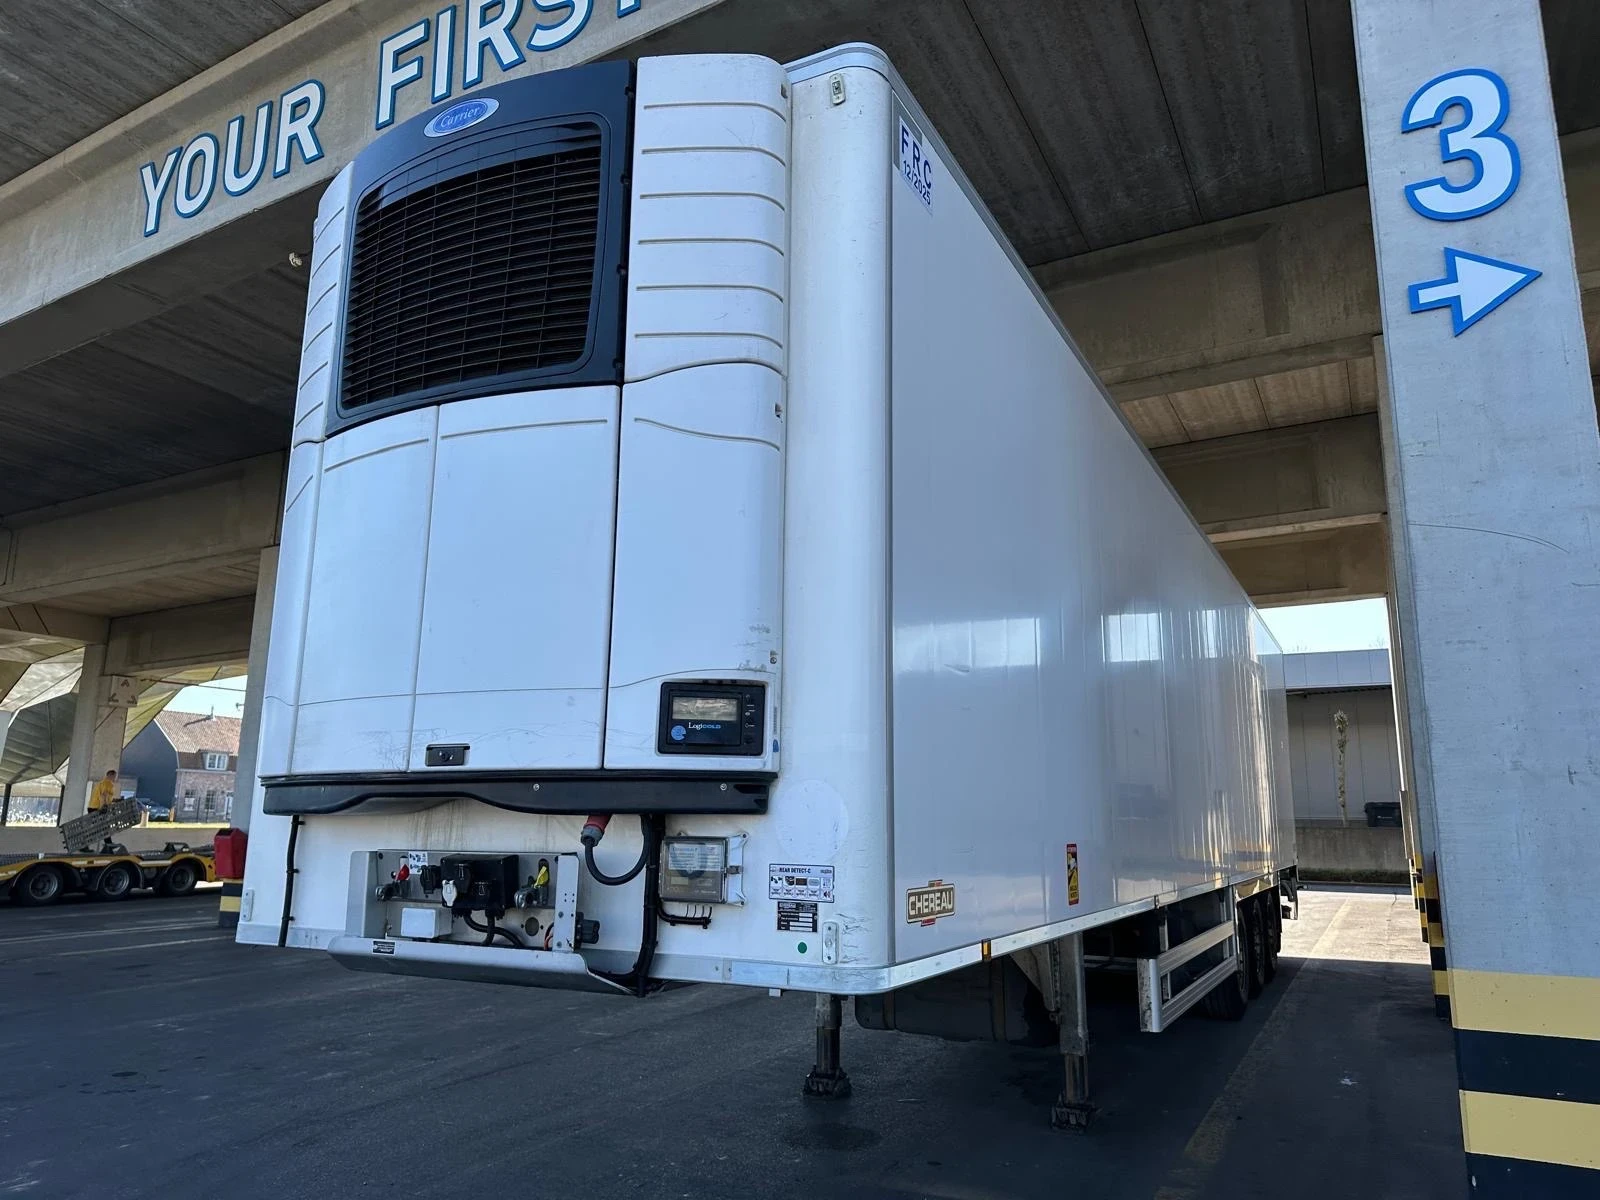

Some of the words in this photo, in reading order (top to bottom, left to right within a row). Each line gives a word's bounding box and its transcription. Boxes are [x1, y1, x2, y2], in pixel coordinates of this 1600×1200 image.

[140, 79, 325, 237] YOUR
[375, 0, 642, 131] FIRS
[440, 106, 481, 128] Carrier
[1401, 68, 1521, 222] 3
[902, 124, 931, 190] FRC
[903, 160, 931, 206] 12/2025
[908, 890, 953, 916] CHEREAU
